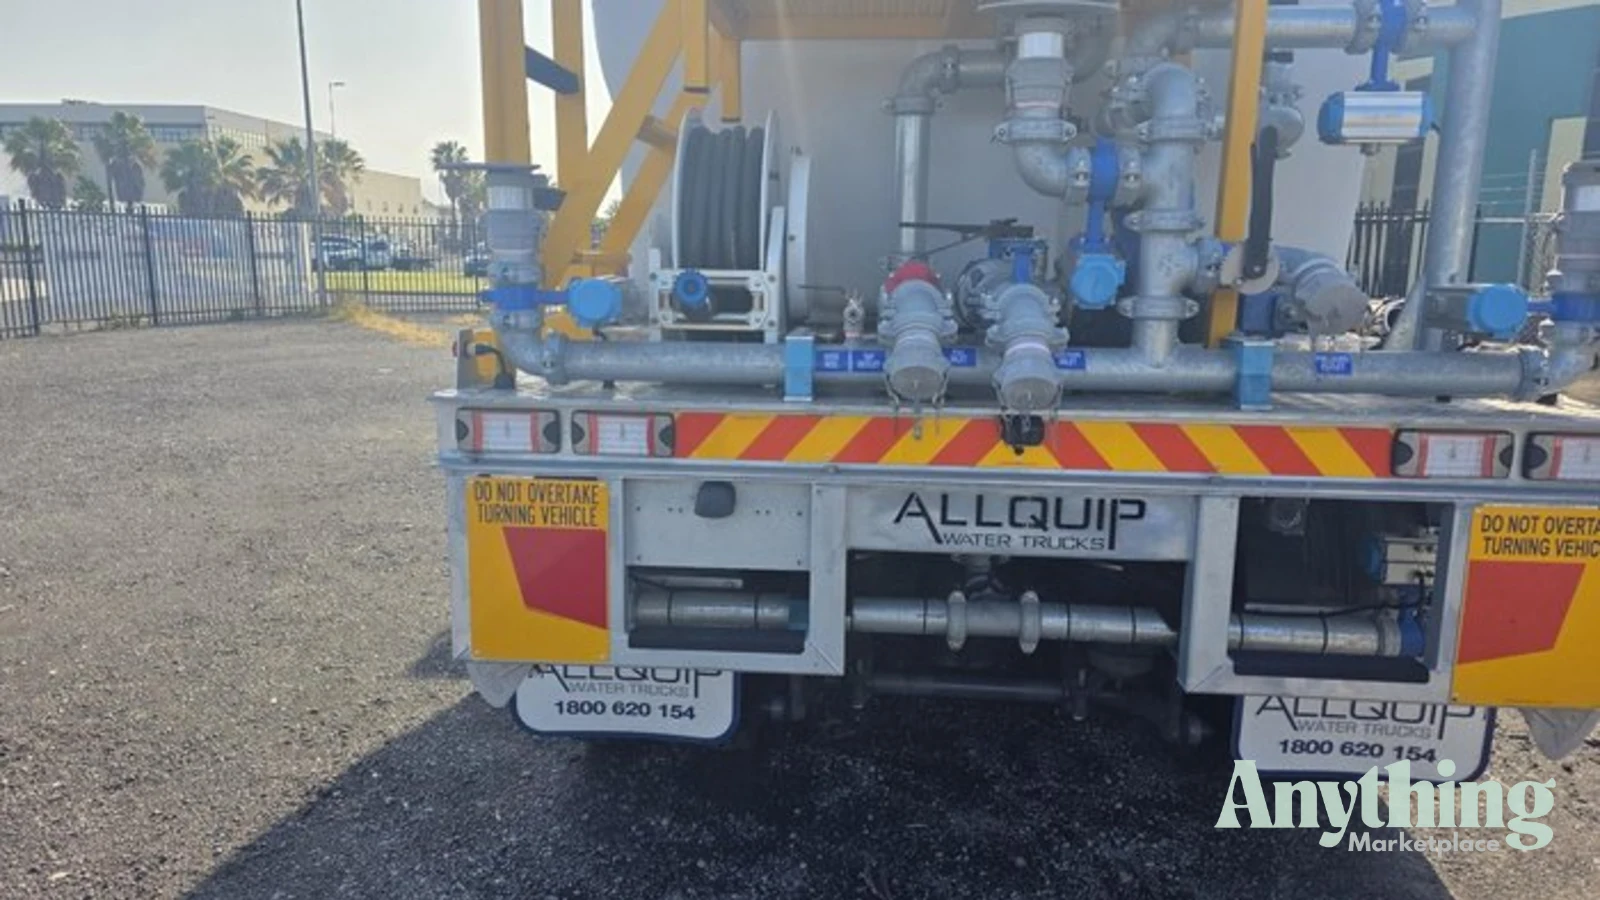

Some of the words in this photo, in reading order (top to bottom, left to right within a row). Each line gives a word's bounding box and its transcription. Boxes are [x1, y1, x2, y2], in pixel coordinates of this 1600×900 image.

[474, 481, 493, 502] DO
[496, 482, 522, 502] NOT
[528, 483, 599, 505] OVERTAKE
[478, 503, 536, 525] TURNING
[540, 505, 598, 527] VEHICLE
[893, 491, 1147, 551] ALLQUIP
[1481, 514, 1504, 533] DO
[1508, 515, 1540, 534] NOT
[942, 533, 1012, 549] WATER
[1020, 536, 1106, 551] TRUCKS
[1483, 536, 1551, 556] TURNING
[568, 682, 625, 695] WATER
[629, 684, 690, 698] TRUCKS
[554, 700, 606, 716] 1800
[612, 701, 651, 717] 620
[658, 704, 696, 720] 154
[1297, 720, 1358, 734] WATER
[1363, 723, 1432, 740] TRUCKS
[1279, 739, 1334, 755] 1800
[1340, 741, 1385, 759] 620
[1392, 746, 1437, 763] 154
